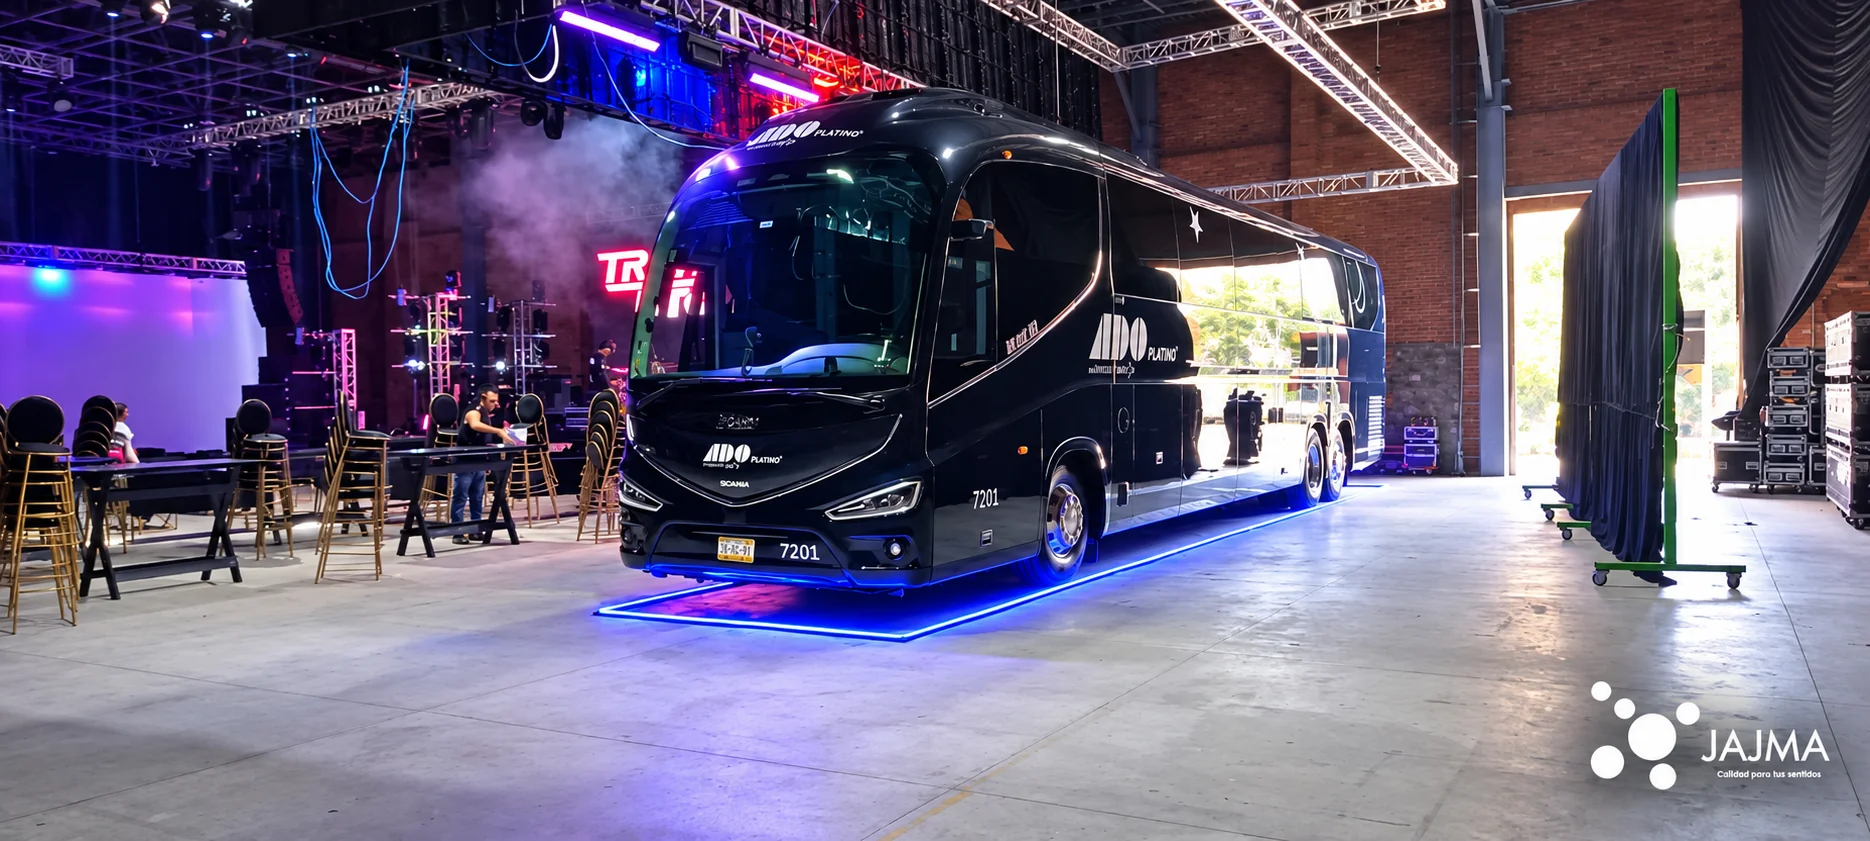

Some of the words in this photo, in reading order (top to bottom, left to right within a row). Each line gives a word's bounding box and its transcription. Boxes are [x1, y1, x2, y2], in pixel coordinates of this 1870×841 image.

[814, 129, 861, 138] PLATINO
[1089, 313, 1148, 362] ADO
[1147, 346, 1177, 362] PLATINO
[703, 443, 751, 463] ADO
[750, 456, 781, 464] PLATINO
[720, 480, 750, 488] SCANIA
[973, 488, 999, 510] 7201
[780, 543, 820, 561] 7201
